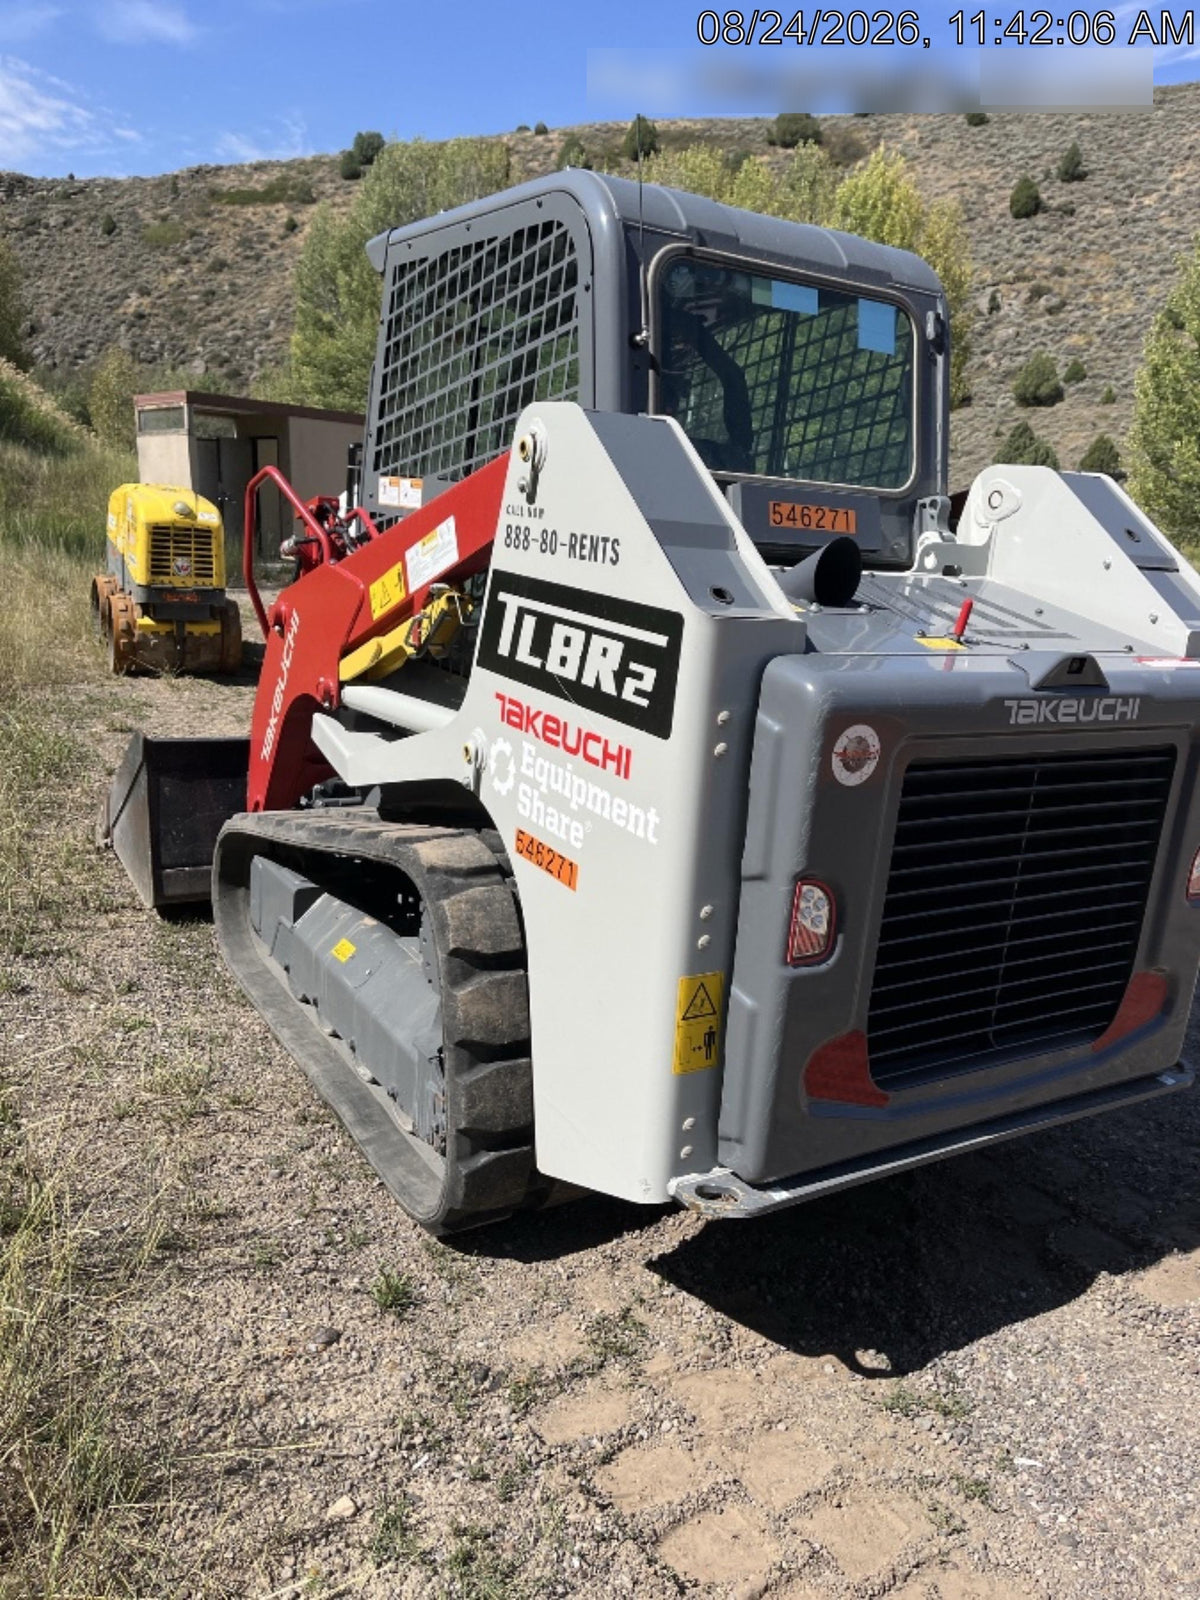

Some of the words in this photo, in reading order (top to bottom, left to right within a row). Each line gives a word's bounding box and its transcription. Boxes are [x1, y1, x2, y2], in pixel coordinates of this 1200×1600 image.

[772, 502, 850, 531] 546271
[504, 523, 621, 566] 888-80-RENTS
[495, 692, 633, 780] TAKEUCHI
[1004, 698, 1141, 724] TAKEUCHI
[520, 741, 660, 845] Equipment
[516, 829, 574, 887] 546271
